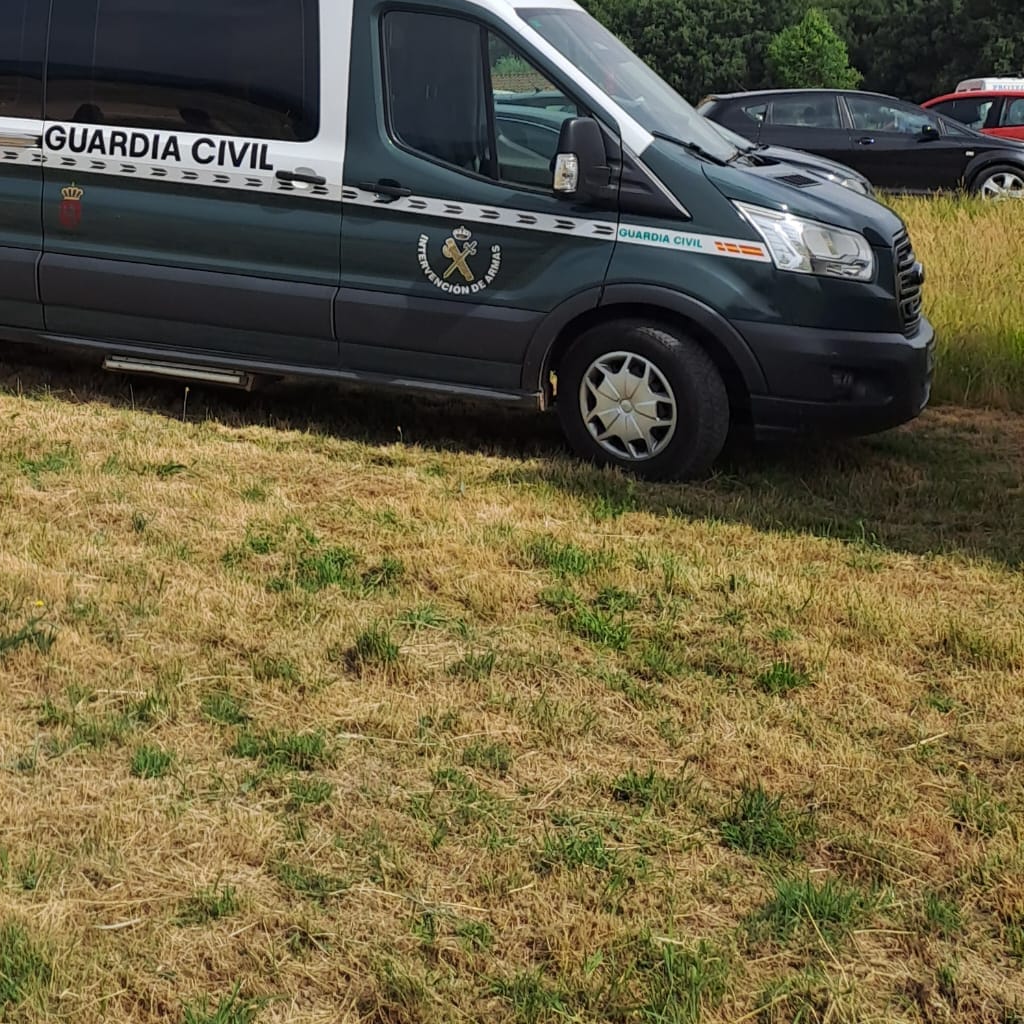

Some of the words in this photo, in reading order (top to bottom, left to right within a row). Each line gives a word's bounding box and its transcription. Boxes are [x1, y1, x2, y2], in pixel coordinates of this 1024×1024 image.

[44, 125, 182, 162] GUARDIA
[191, 137, 274, 171] CIVIL
[619, 228, 670, 243] GUARDIA
[673, 236, 703, 248] CIVIL
[417, 233, 470, 295] INTERVENCIÓN
[470, 279, 486, 293] DE
[484, 244, 501, 284] ARMAS
